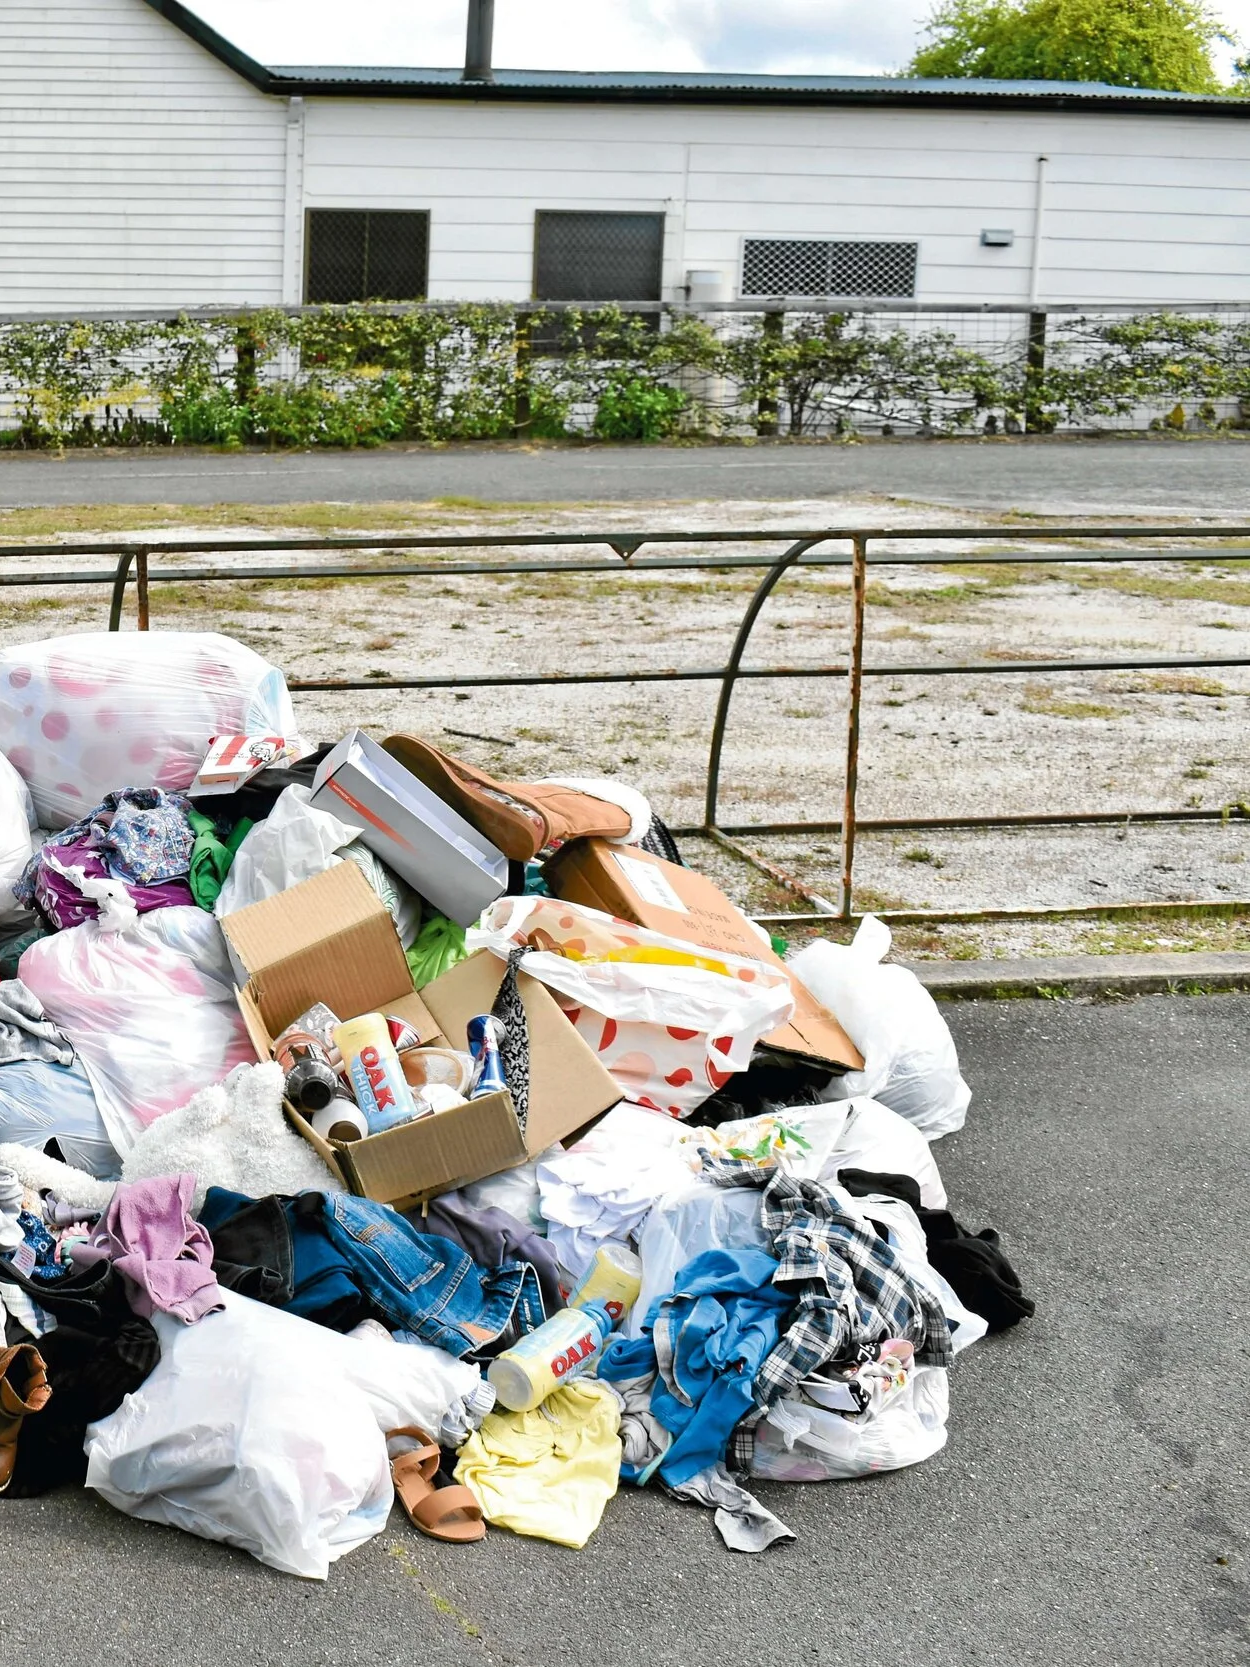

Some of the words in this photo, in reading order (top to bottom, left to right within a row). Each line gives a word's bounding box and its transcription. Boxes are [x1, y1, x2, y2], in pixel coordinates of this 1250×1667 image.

[351, 1064, 378, 1117] THICK
[360, 1046, 397, 1112] OAK
[550, 1332, 597, 1378] OAK
